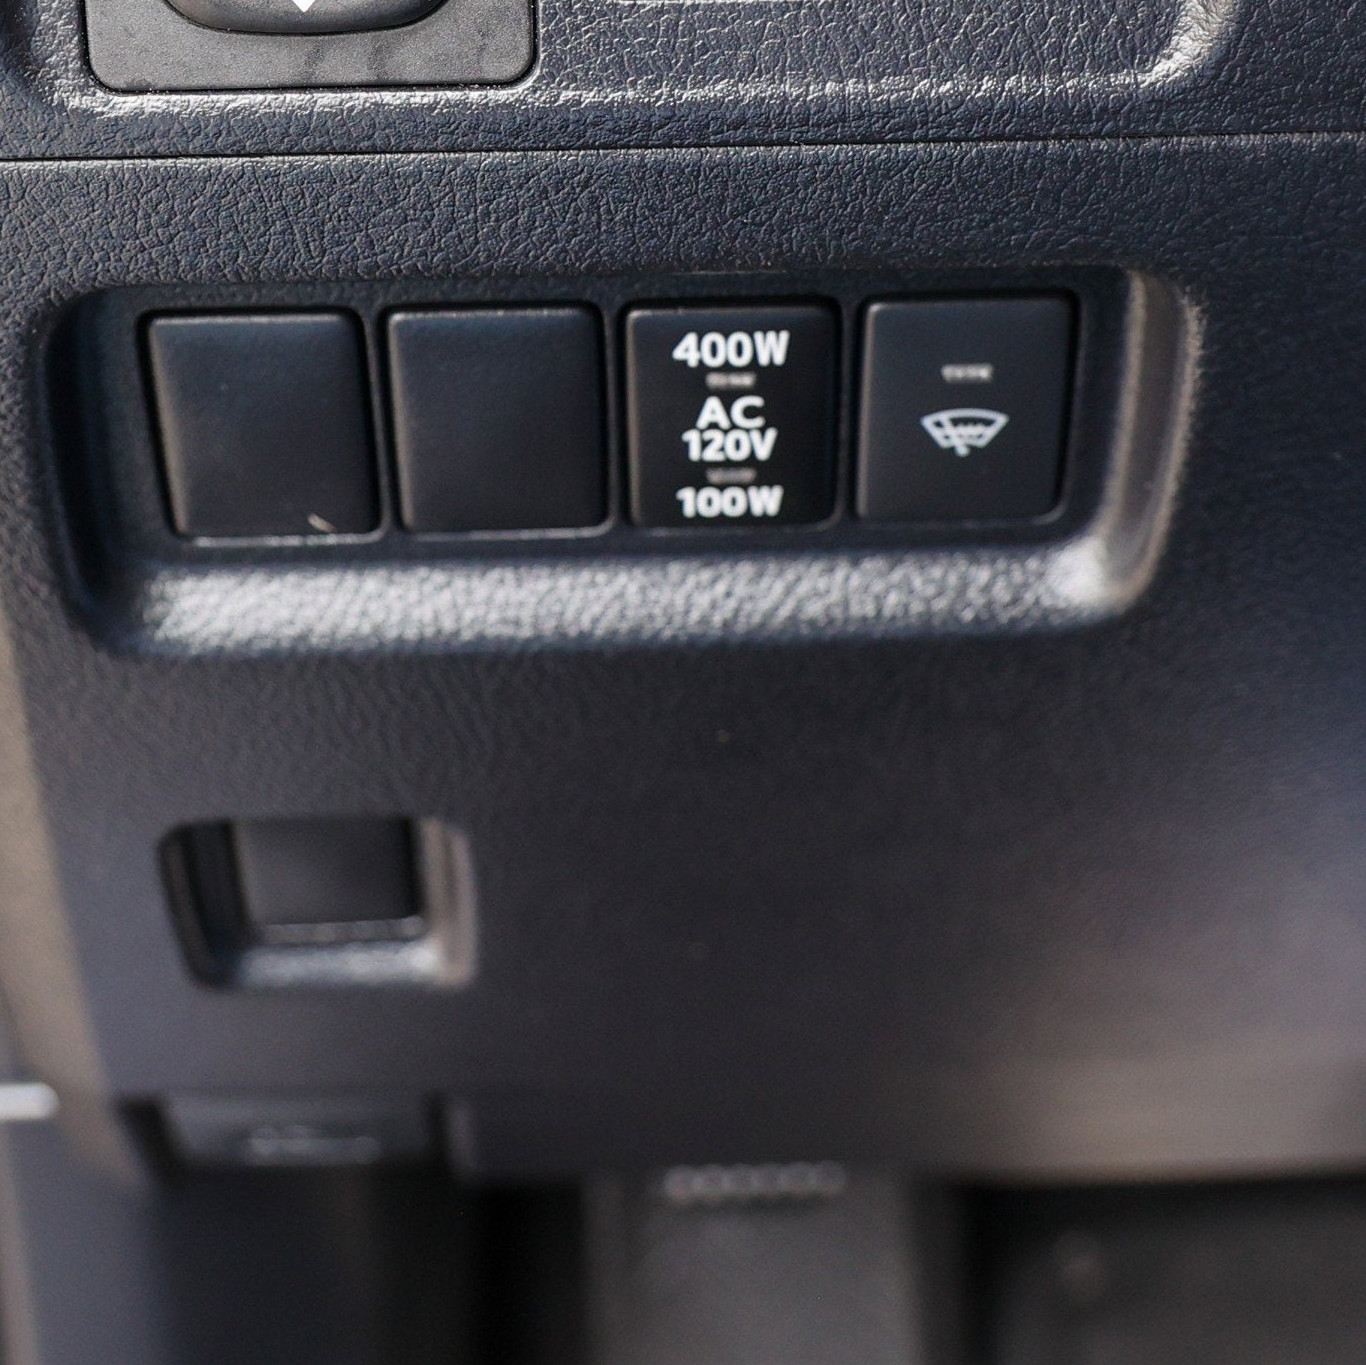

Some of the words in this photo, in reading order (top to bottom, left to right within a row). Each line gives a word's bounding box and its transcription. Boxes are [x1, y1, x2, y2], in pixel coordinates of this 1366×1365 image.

[672, 330, 790, 368] 400W
[695, 395, 766, 430] AC
[681, 427, 778, 462] 120V
[675, 485, 784, 519] 100W
